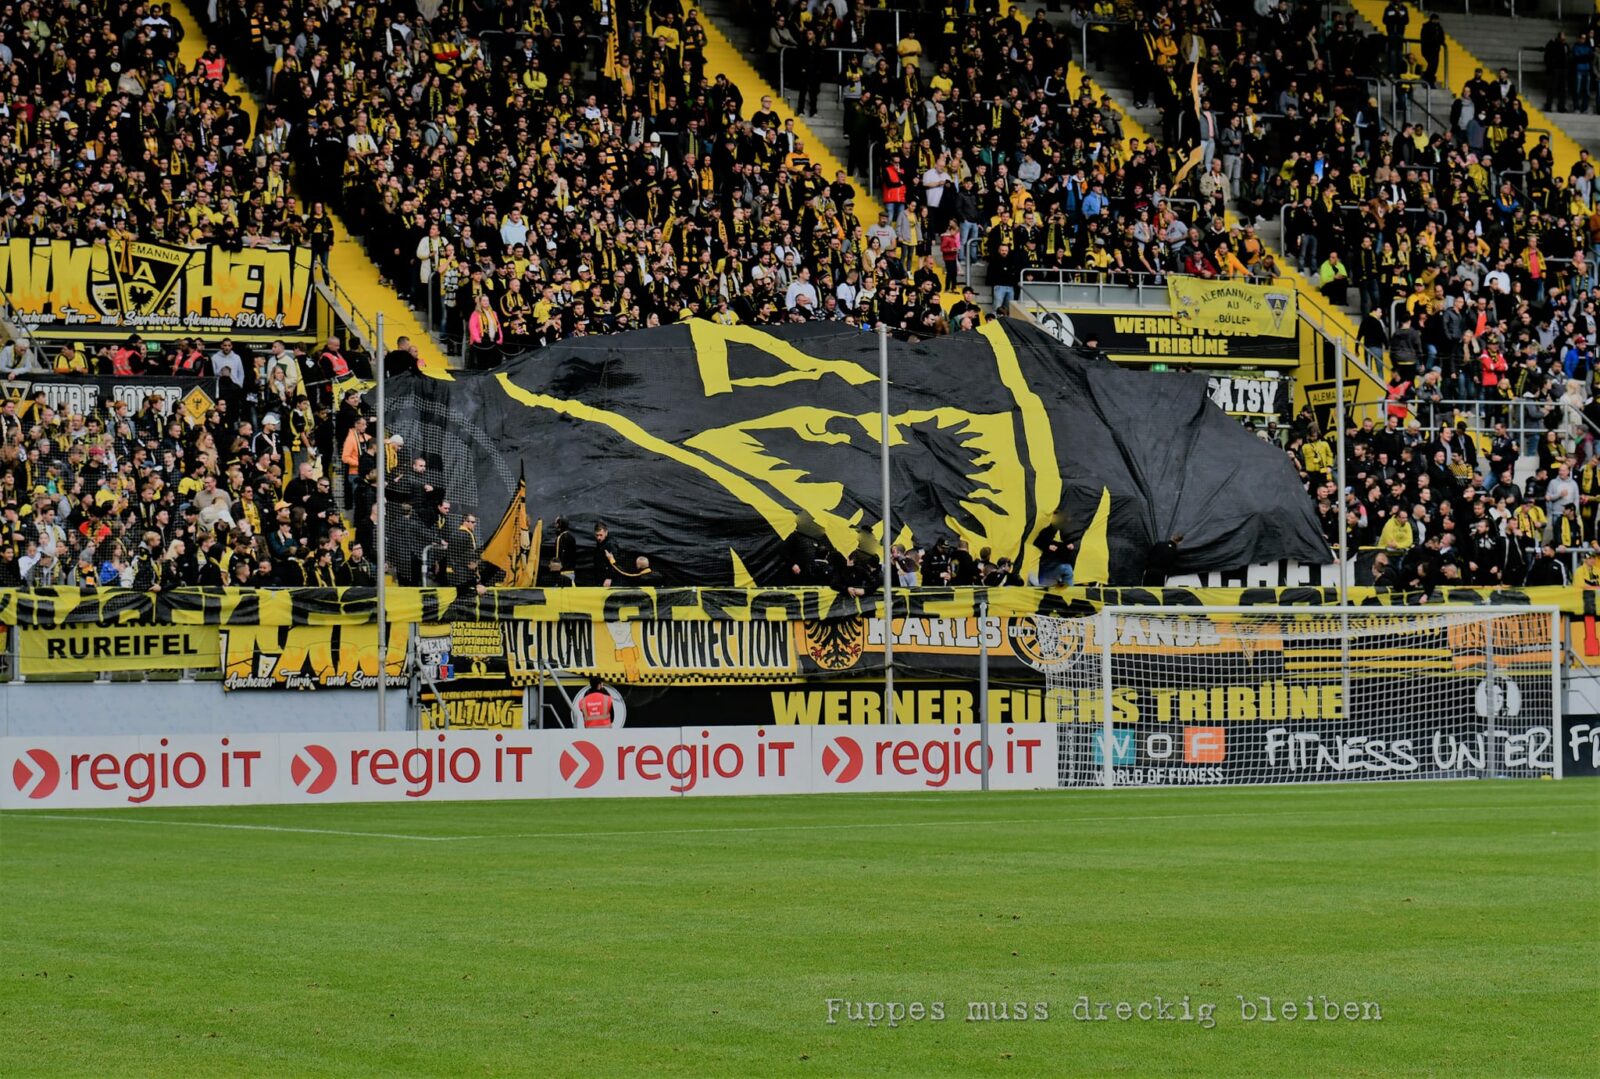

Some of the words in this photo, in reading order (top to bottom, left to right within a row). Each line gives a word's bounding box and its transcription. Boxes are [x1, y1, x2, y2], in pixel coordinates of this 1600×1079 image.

[115, 240, 181, 262] AEMANNIA
[1146, 335, 1229, 356] TRIBÜNE
[47, 634, 199, 660] RUREIFEL
[505, 620, 596, 671] YELLOW
[641, 620, 790, 668] CONNECTION
[867, 617, 1003, 647] KARLS
[225, 671, 277, 688] Aachener
[326, 672, 347, 687] und
[431, 700, 514, 728] HALTUNG
[771, 690, 974, 725] WERNER
[986, 688, 1140, 724] FUCHS
[1156, 680, 1345, 721] TRIBÜNE
[351, 733, 482, 798] regio
[495, 733, 533, 783] iT
[617, 729, 744, 793] regio
[757, 729, 795, 777] iT
[875, 727, 994, 787] regio
[1006, 727, 1042, 775] iT
[1264, 727, 1419, 772] FITNESS
[1433, 726, 1554, 770] UNTER
[70, 737, 207, 803] regio
[221, 736, 262, 788] iT
[1167, 766, 1224, 783] FITNESS
